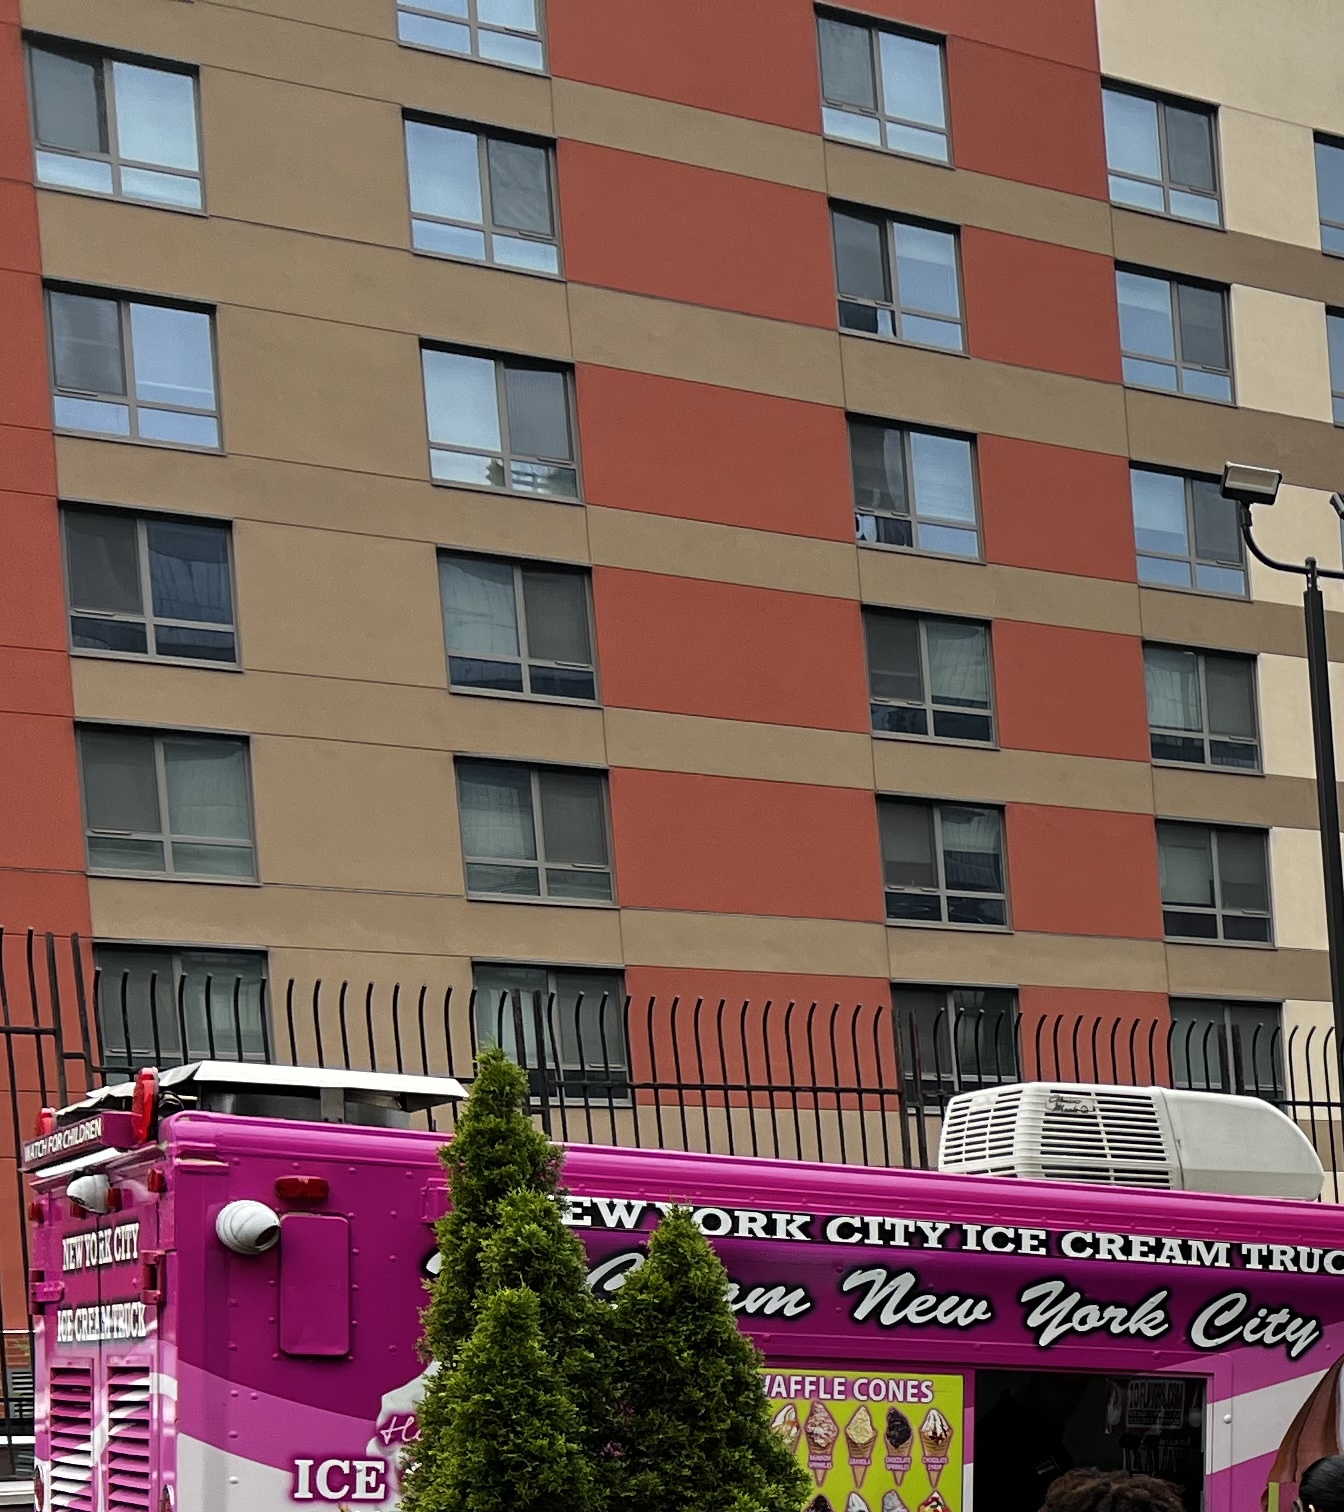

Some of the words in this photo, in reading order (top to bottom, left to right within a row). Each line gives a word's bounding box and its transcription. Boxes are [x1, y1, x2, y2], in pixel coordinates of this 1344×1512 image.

[24, 1137, 48, 1162] WATCH
[48, 1132, 63, 1155] FOR
[62, 1118, 101, 1148] CHILDREN
[62, 1235, 84, 1271] NEW
[84, 1228, 113, 1266] YORK
[113, 1222, 140, 1263] CITY
[548, 1195, 647, 1229] EW
[826, 1215, 950, 1249] CITY
[961, 1224, 1047, 1255] ICE
[1060, 1231, 1231, 1268] CREAM
[57, 1307, 74, 1343] ICE
[74, 1303, 113, 1342] CREAM
[112, 1300, 147, 1339] TRUCK
[842, 1268, 991, 1326] New
[1020, 1281, 1170, 1347] York
[1190, 1292, 1320, 1358] City
[853, 1378, 933, 1403] CONES
[294, 1458, 386, 1500] ICE
